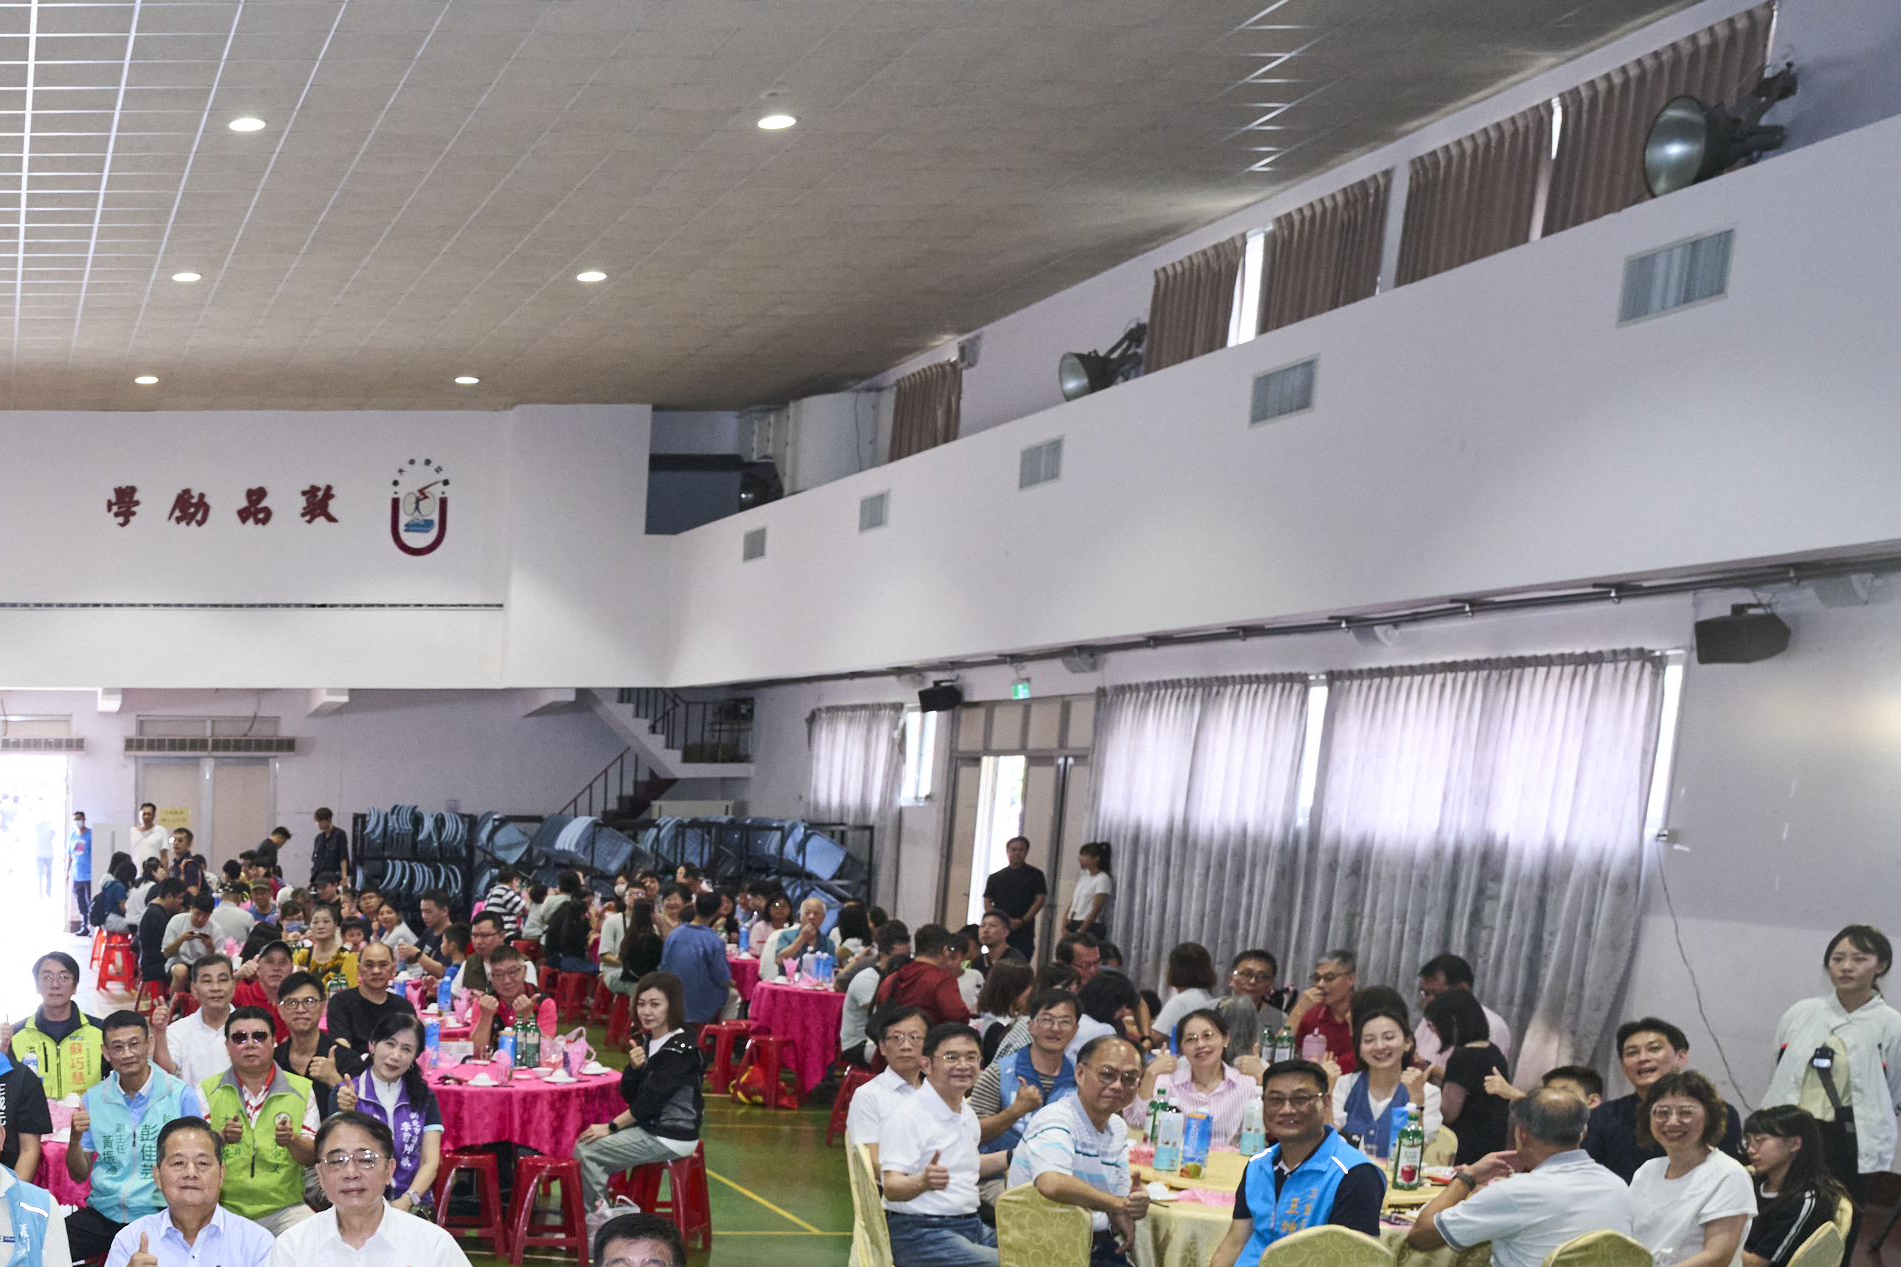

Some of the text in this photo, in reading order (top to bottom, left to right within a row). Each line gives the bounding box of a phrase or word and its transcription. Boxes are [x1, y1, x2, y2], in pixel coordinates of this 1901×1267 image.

[70, 1042, 85, 1085] 蘇巧慧
[115, 1123, 126, 1154] 副主任
